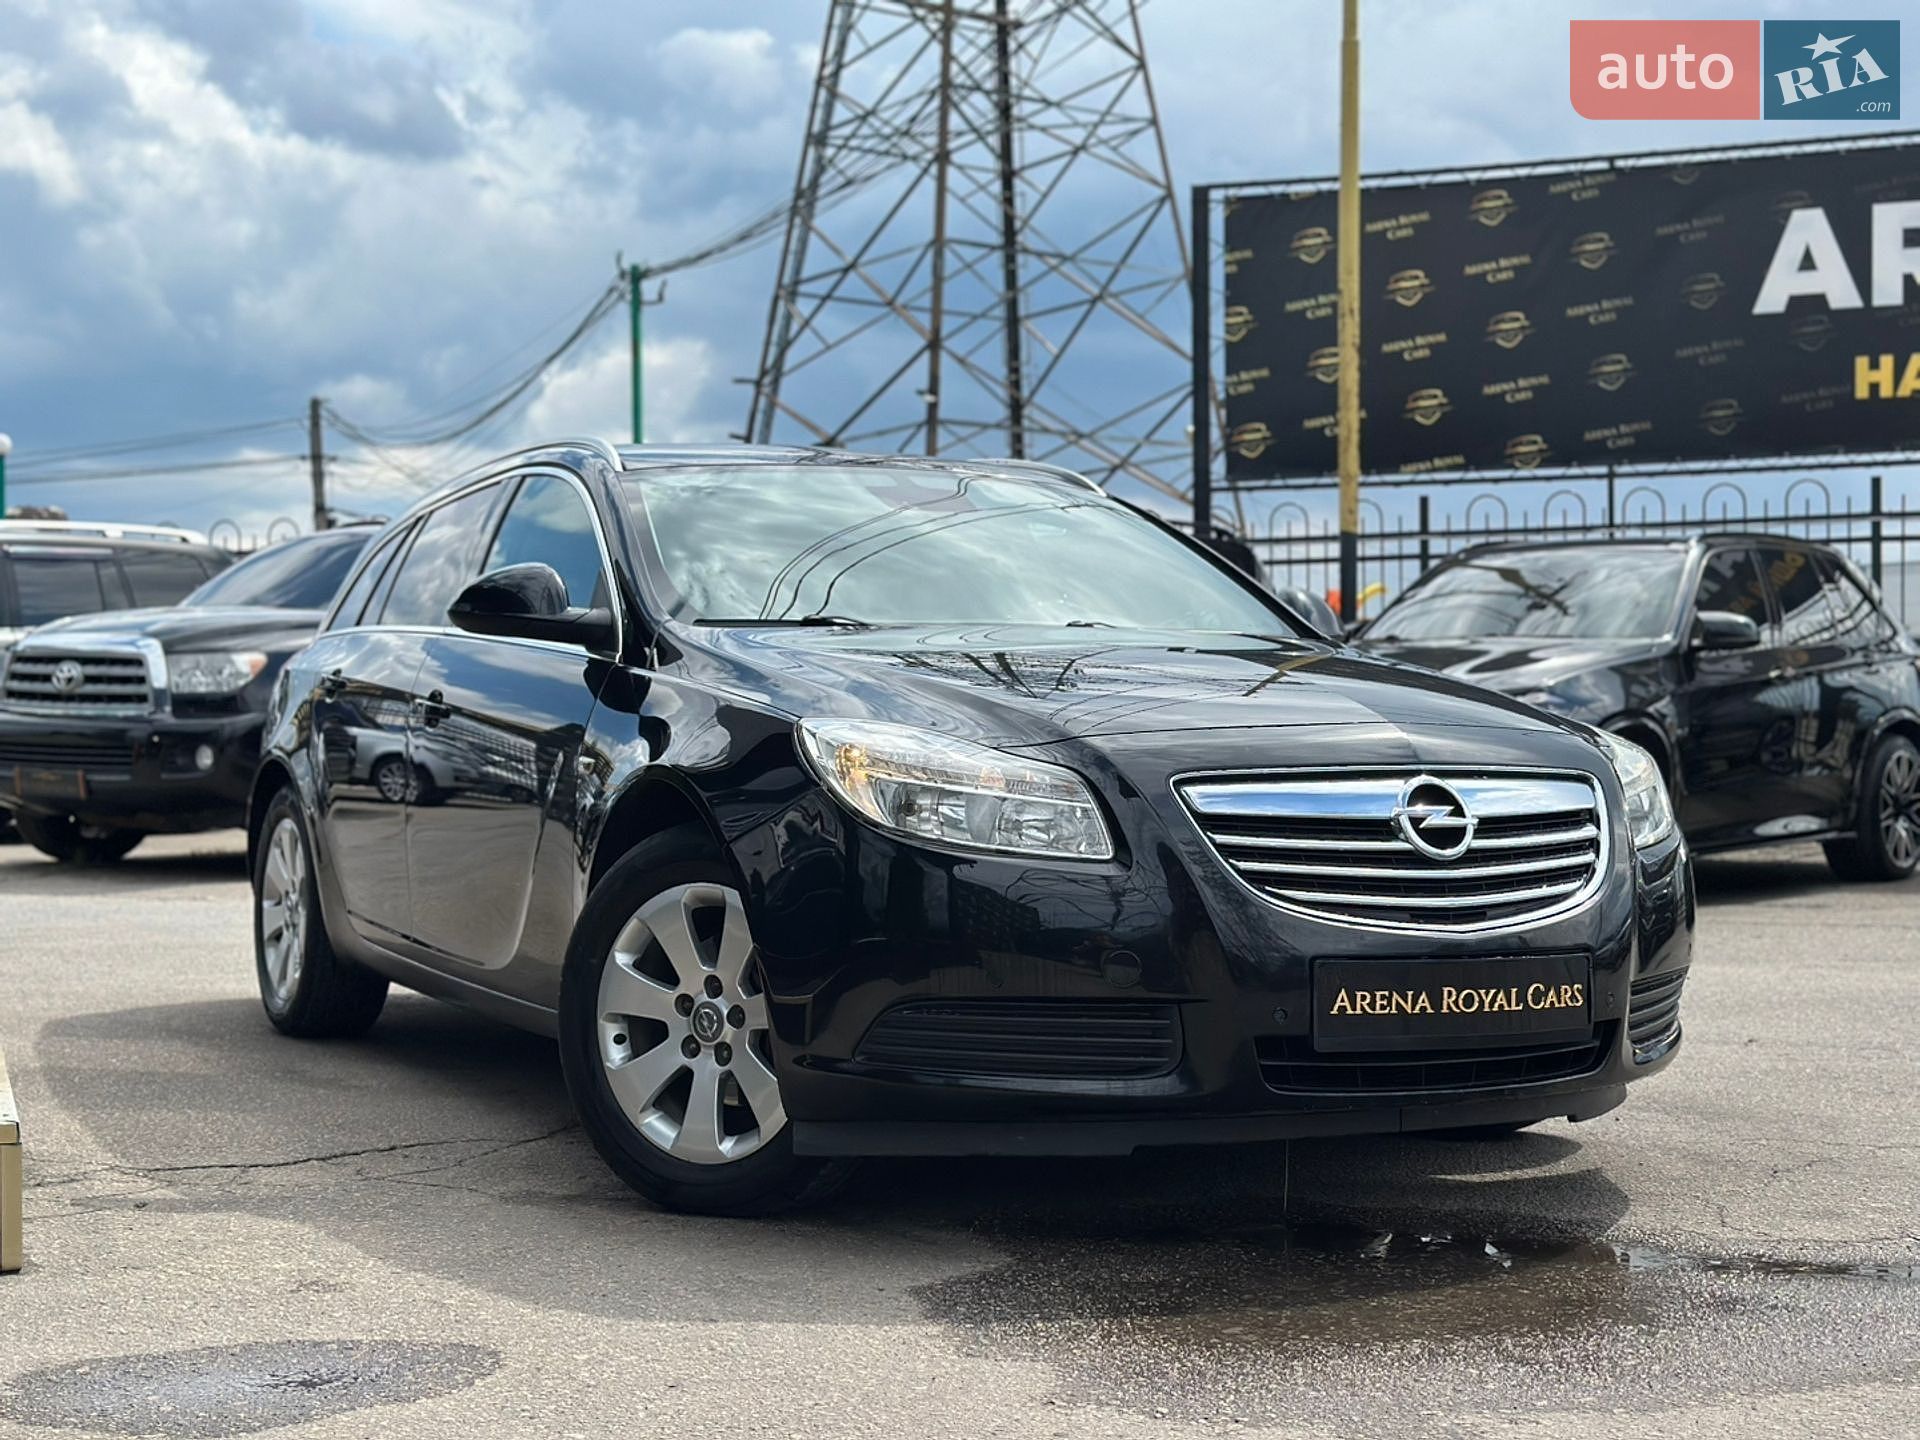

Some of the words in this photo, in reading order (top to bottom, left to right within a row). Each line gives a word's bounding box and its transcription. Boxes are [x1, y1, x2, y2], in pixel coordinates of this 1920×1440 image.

[1329, 987, 1435, 1015] ARENA
[1441, 986, 1523, 1014] ROYAL
[1527, 982, 1584, 1010] CARS
